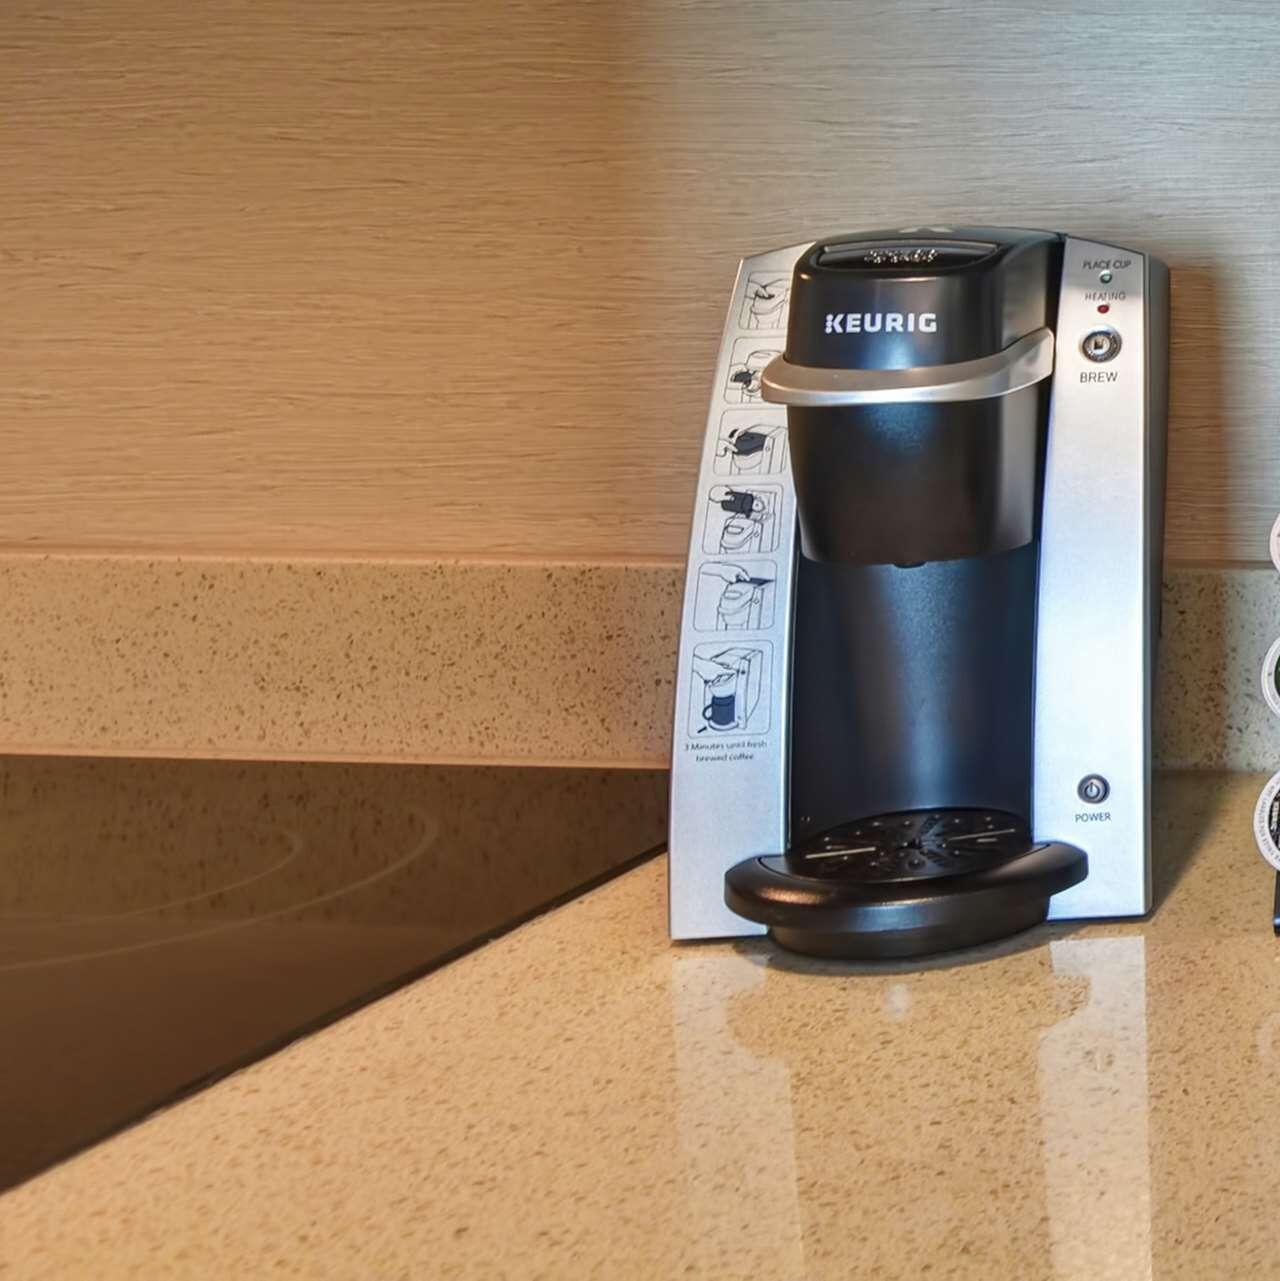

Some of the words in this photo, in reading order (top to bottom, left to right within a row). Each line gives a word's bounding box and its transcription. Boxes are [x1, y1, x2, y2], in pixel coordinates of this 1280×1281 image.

[1113, 260, 1132, 269] CUP
[1085, 292, 1126, 300] HEATING
[825, 312, 938, 334] KEURIG
[1080, 372, 1118, 383] BREW
[1075, 812, 1111, 822] POWER
